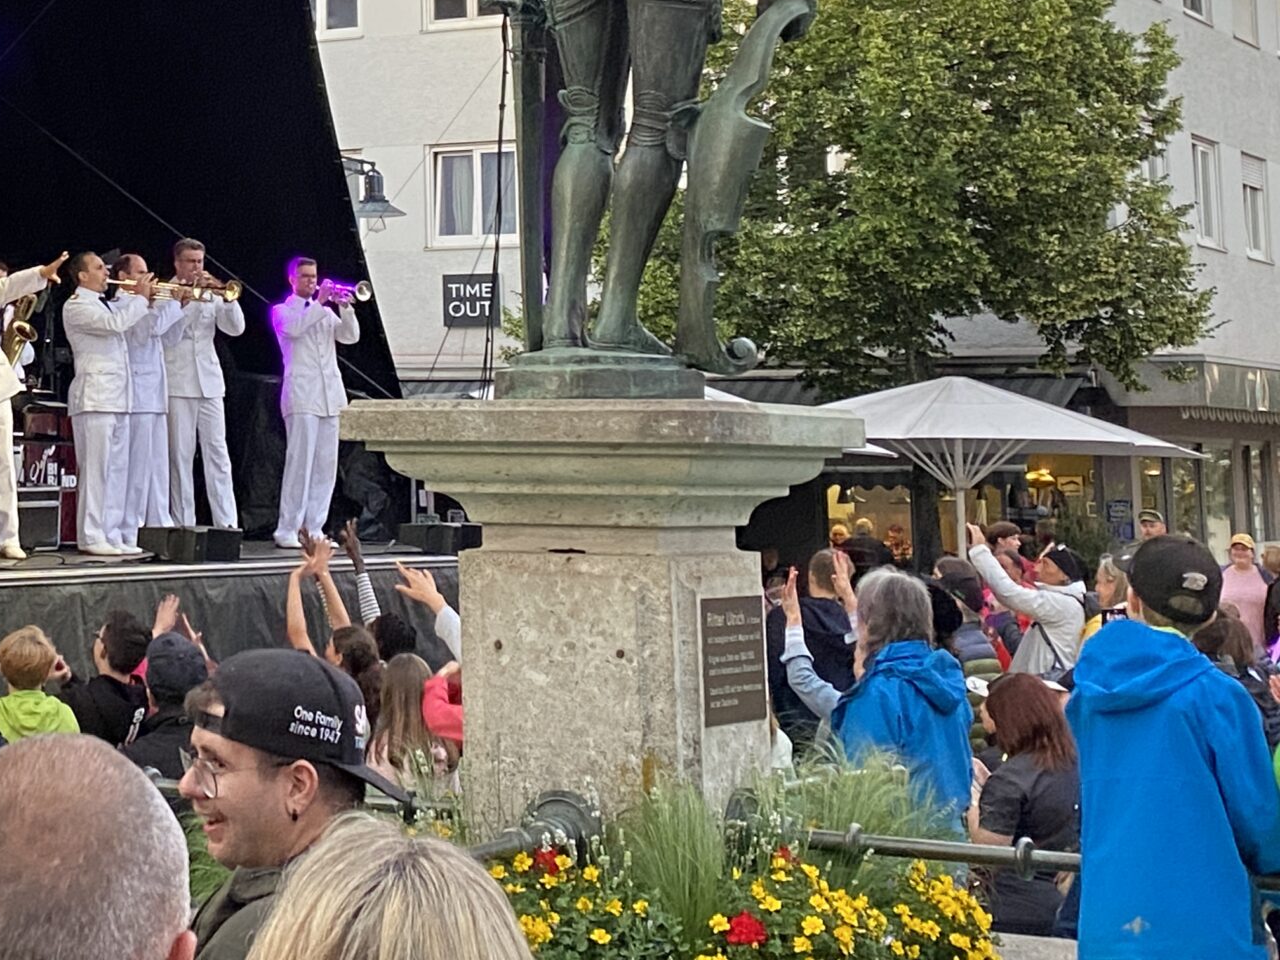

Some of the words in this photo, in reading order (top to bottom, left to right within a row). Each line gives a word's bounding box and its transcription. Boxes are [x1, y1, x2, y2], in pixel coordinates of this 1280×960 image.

[447, 283, 493, 298] TIME
[448, 300, 491, 317] OUT
[293, 705, 314, 722] One
[315, 711, 343, 731] Family
[288, 721, 318, 738] since
[319, 727, 342, 744] 1947
